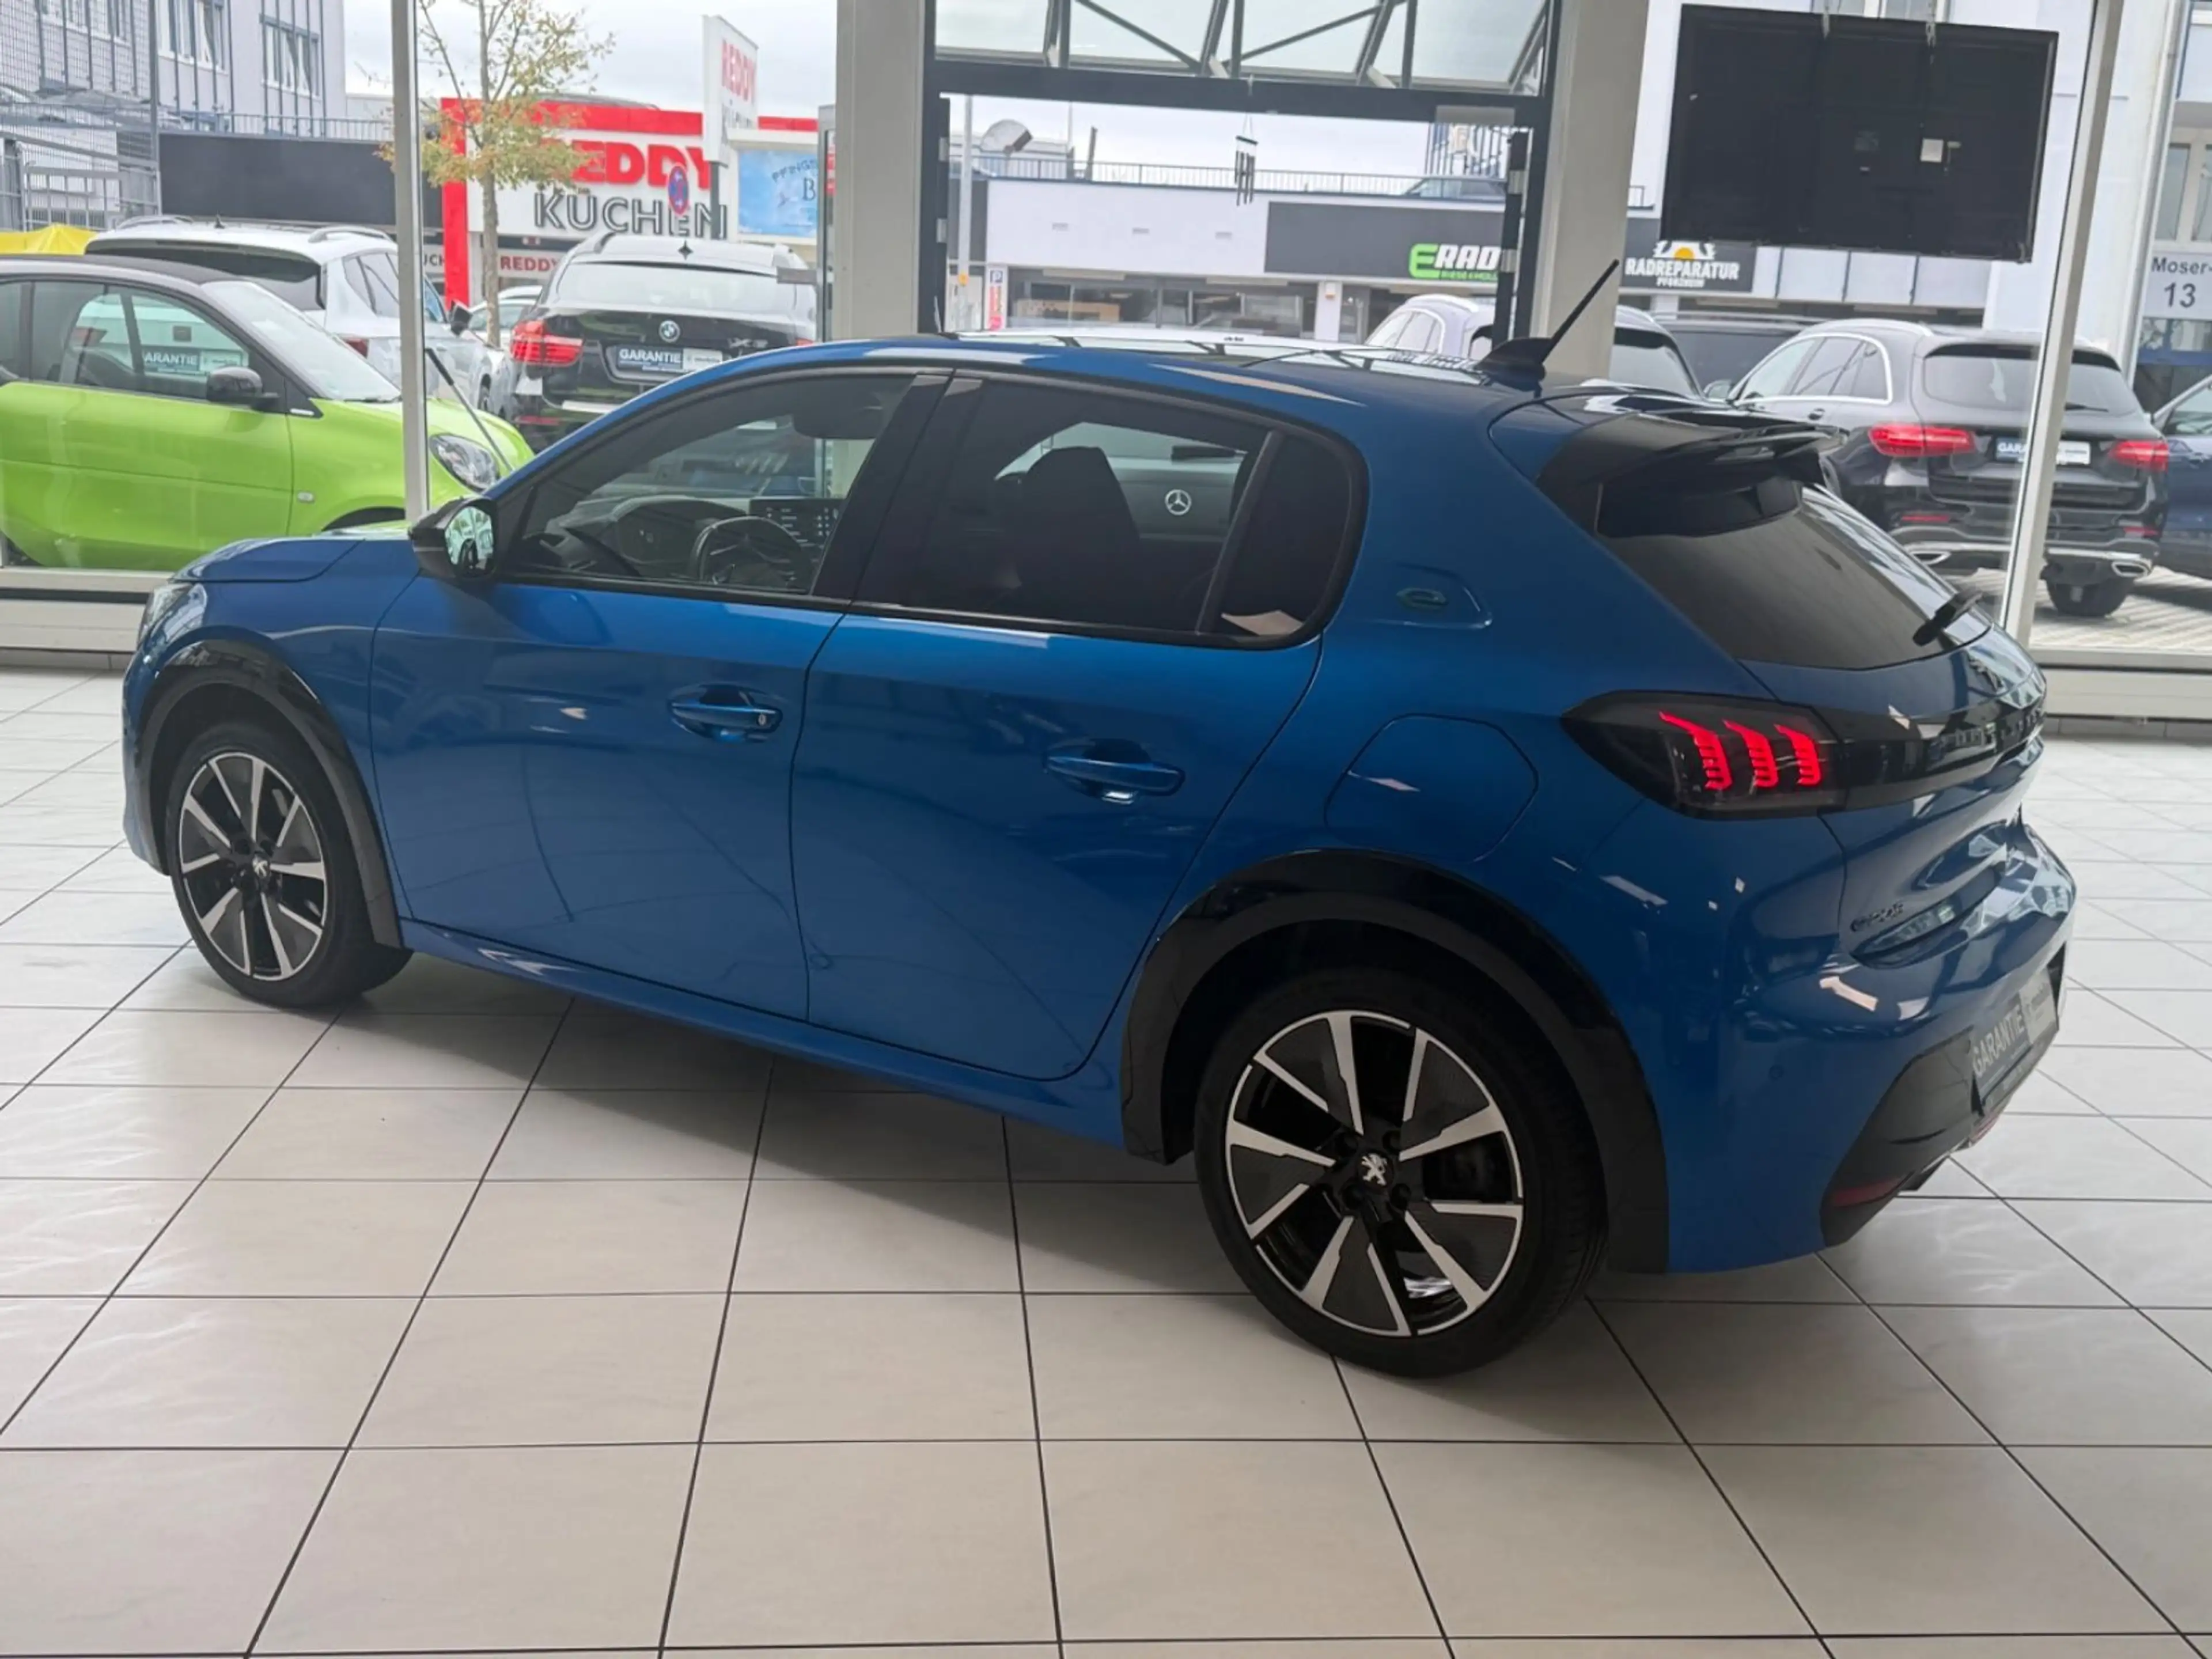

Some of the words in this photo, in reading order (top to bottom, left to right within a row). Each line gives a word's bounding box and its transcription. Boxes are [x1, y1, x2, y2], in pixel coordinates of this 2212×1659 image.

[540, 137, 713, 190] EDDY
[1624, 257, 1740, 280] RADREPARATUR
[2164, 282, 2196, 308] 13
[144, 351, 198, 365] ARANTIE
[619, 348, 681, 363] GARANTIE
[1972, 1004, 2025, 1078] GARANTIE
